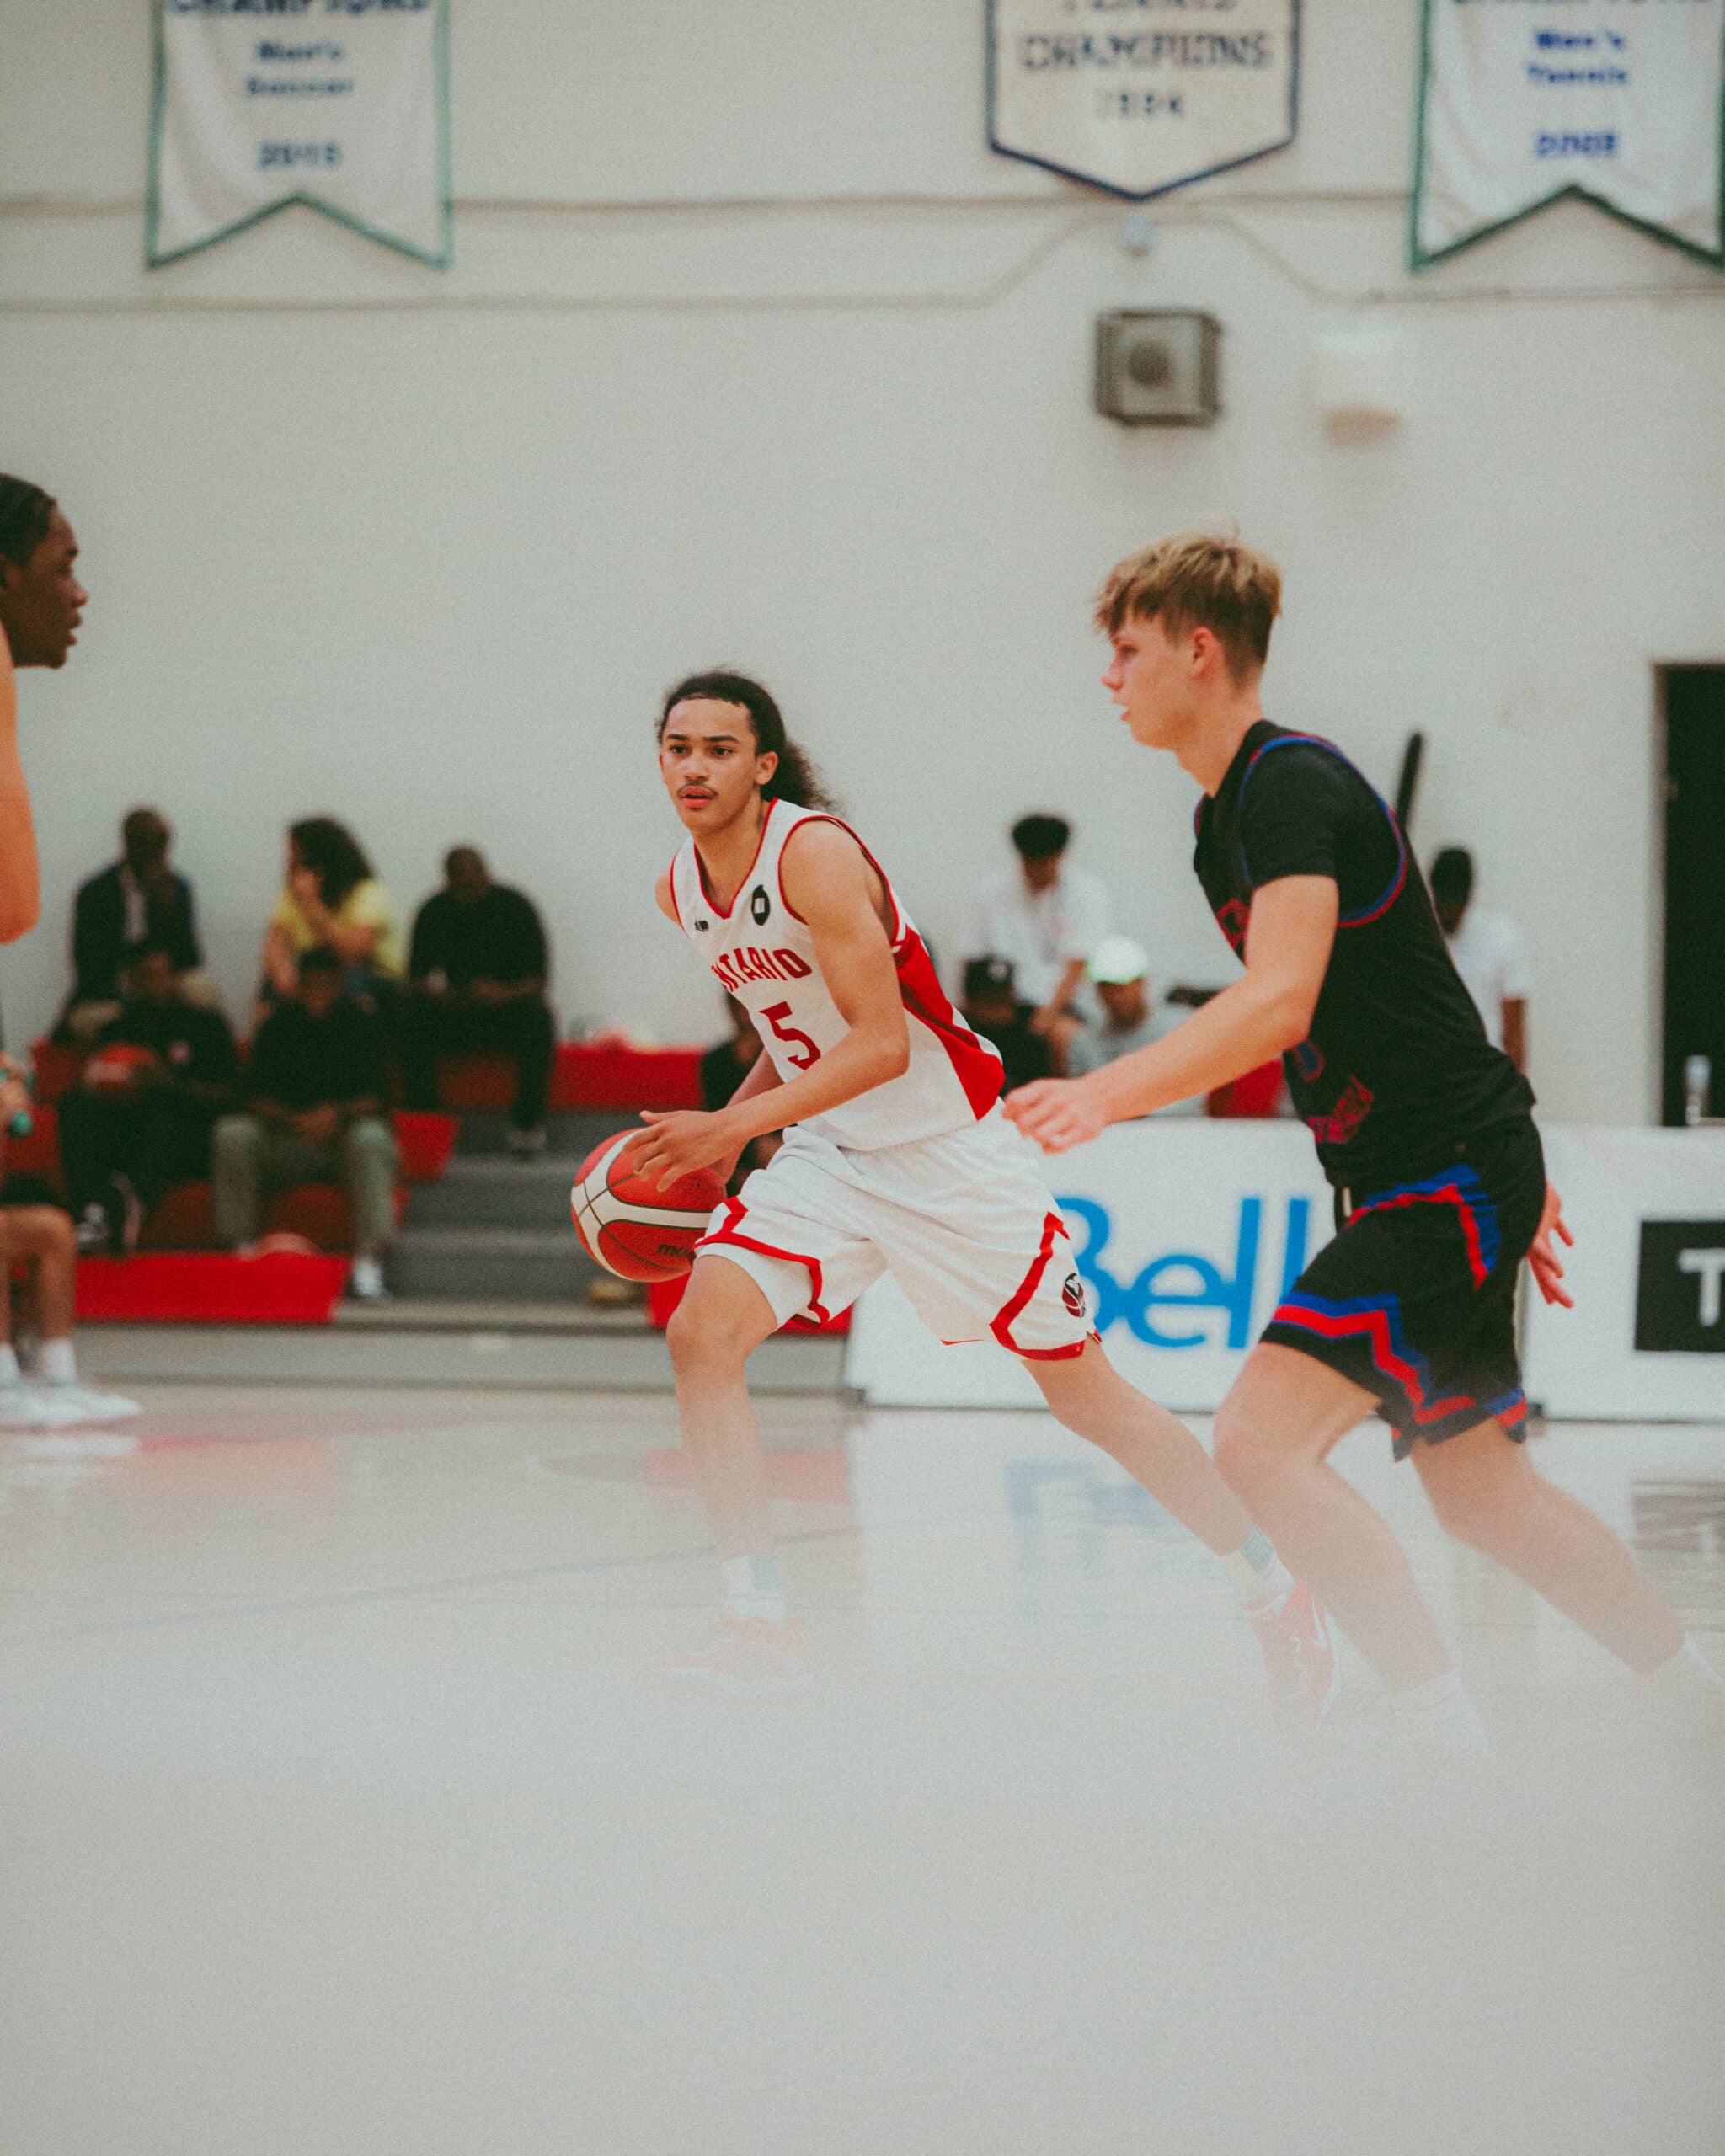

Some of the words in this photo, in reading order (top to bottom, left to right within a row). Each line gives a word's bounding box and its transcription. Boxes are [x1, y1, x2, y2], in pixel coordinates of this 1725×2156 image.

[710, 947, 814, 992] NTARIO
[758, 1001, 822, 1071] 5
[1053, 1196, 1310, 1349] Bell
